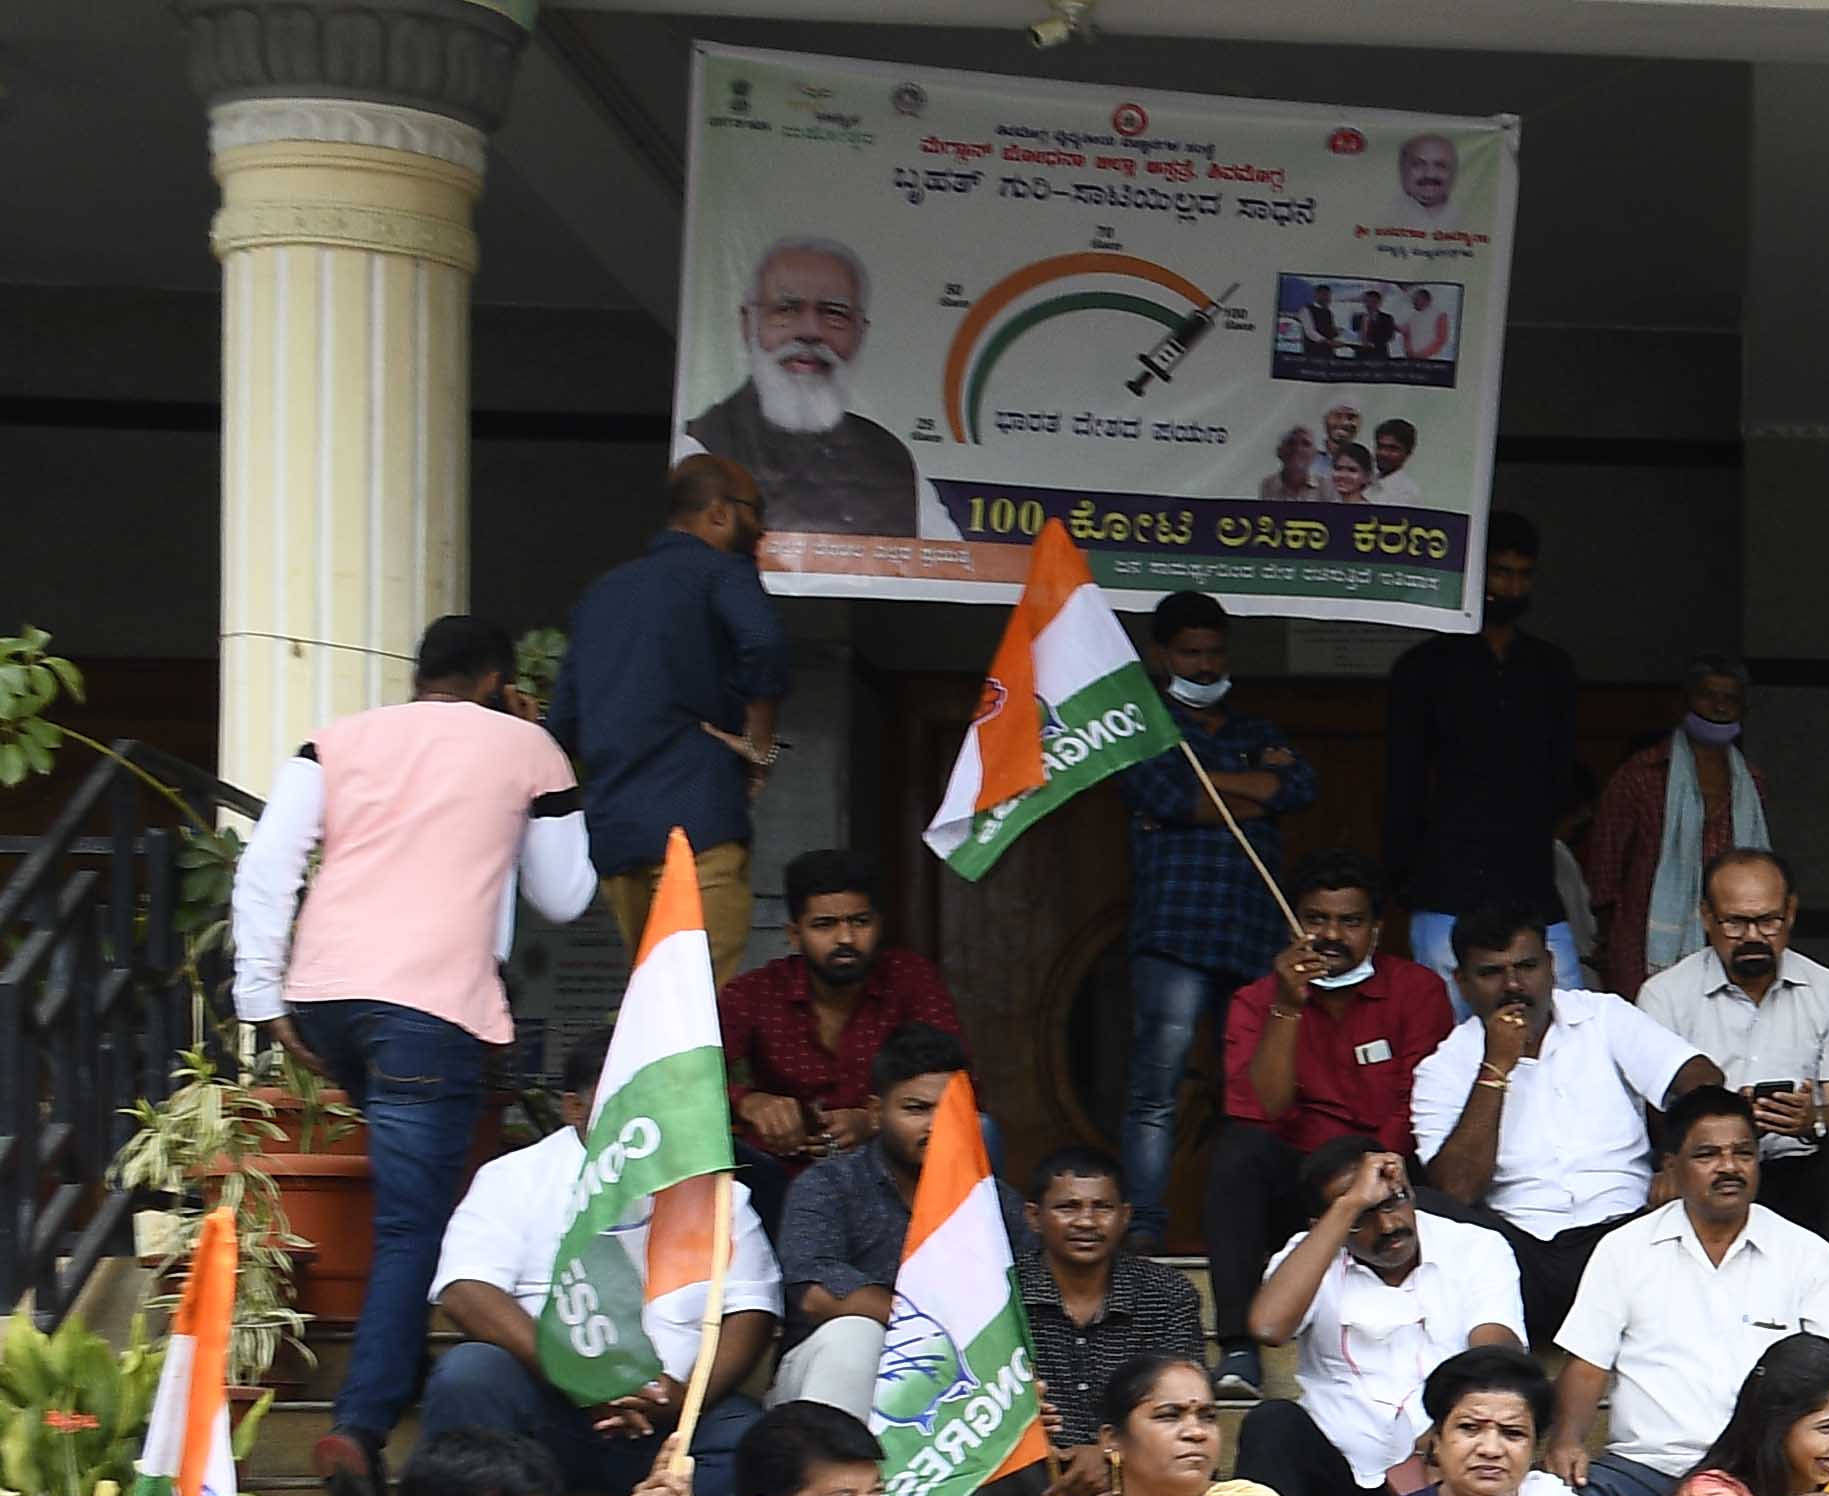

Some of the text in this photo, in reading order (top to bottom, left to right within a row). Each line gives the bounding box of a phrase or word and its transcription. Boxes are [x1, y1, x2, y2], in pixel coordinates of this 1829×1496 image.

[894, 167, 985, 205] ಬೃಹತ್
[1236, 194, 1317, 227] ಸಾಧನೆ
[996, 410, 1061, 434] ಭಾರತ
[967, 497, 1449, 560] 100 ಕೋಟಿ ಲಸಿಕಾ ಕರಣ
